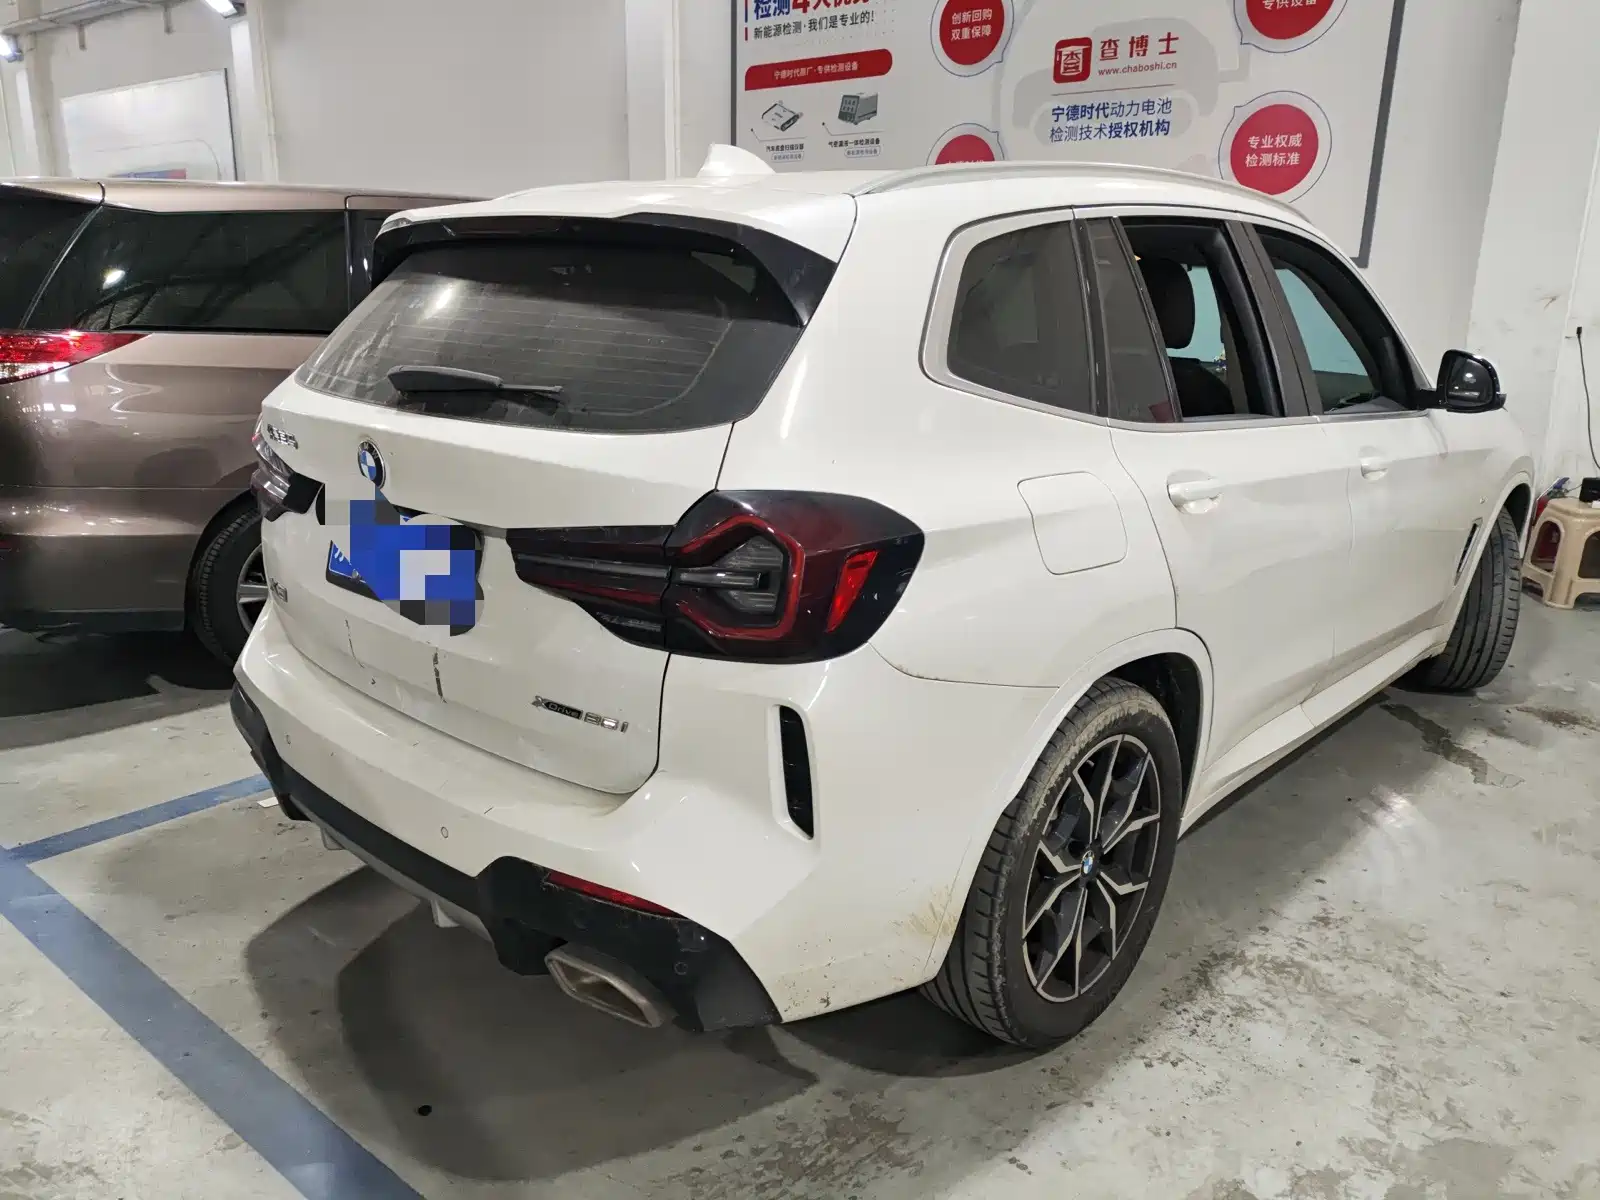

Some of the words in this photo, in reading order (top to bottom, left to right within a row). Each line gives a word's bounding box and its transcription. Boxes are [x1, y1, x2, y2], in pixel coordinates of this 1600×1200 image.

[951, 8, 993, 25] 创新回购
[950, 24, 992, 42] 双重保障
[1099, 31, 1180, 61] 查博士
[1098, 61, 1178, 76] www.chaboshi.cn
[1051, 97, 1173, 122] 宁德时代动力电池
[1049, 119, 1171, 143] 检测技术授权机构
[1247, 132, 1303, 149] 专业权威
[1244, 151, 1301, 168] 检测标准
